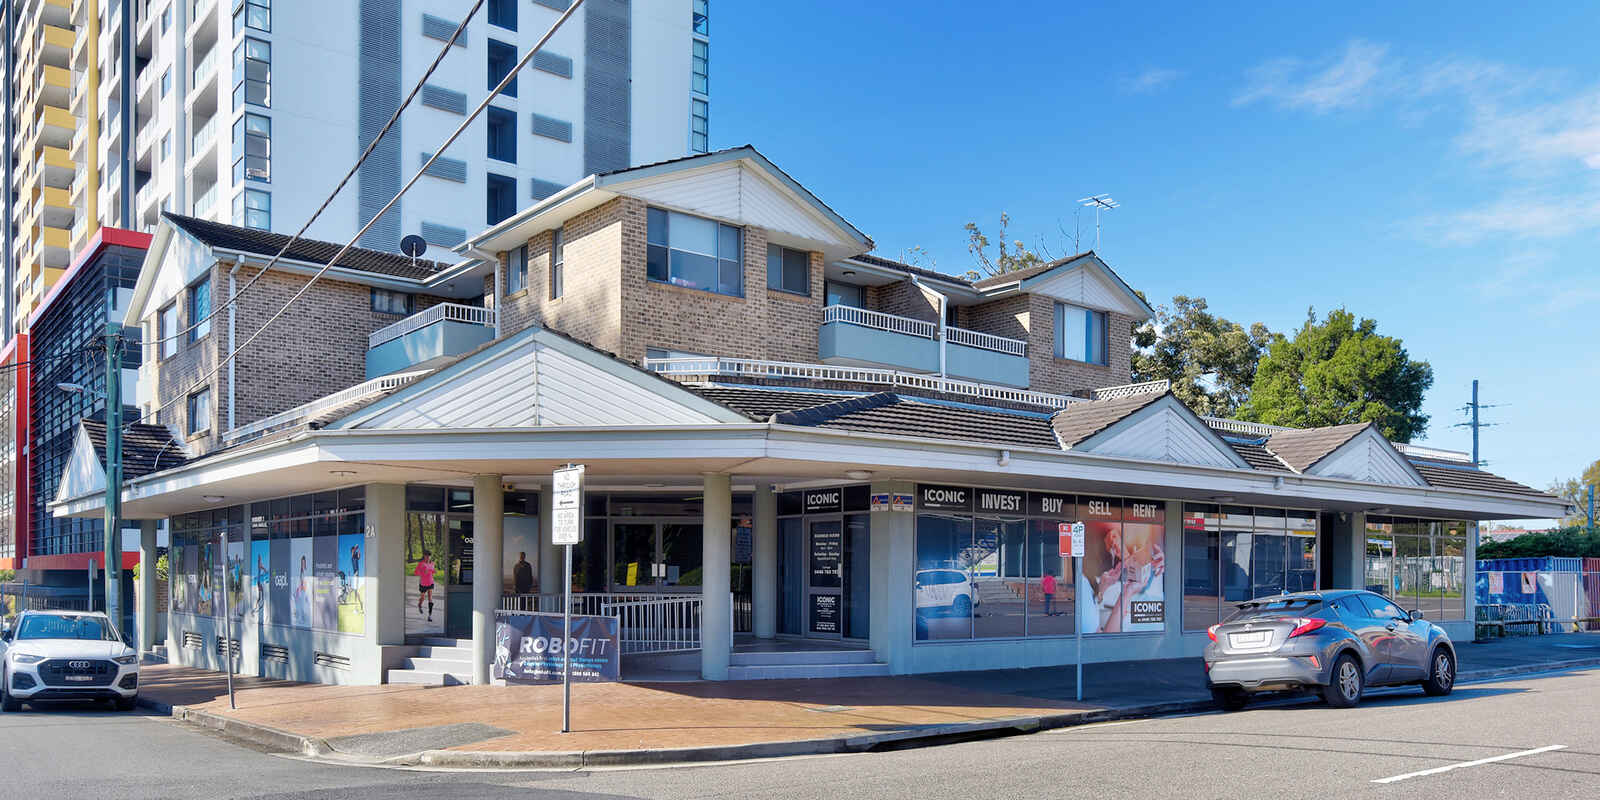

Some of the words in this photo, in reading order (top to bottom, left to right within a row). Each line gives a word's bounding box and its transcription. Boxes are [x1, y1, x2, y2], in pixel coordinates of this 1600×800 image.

[807, 493, 839, 505] ICONIC
[924, 489, 965, 503] ICONIC
[981, 493, 1022, 511] INVEST
[1042, 498, 1064, 513] BUY
[1088, 500, 1112, 516] SELL
[1133, 503, 1157, 518] RENT
[366, 525, 376, 538] 2A
[1073, 525, 1083, 534] 4P
[1134, 602, 1163, 613] ICONIC
[520, 636, 611, 656] ROBOFIT
